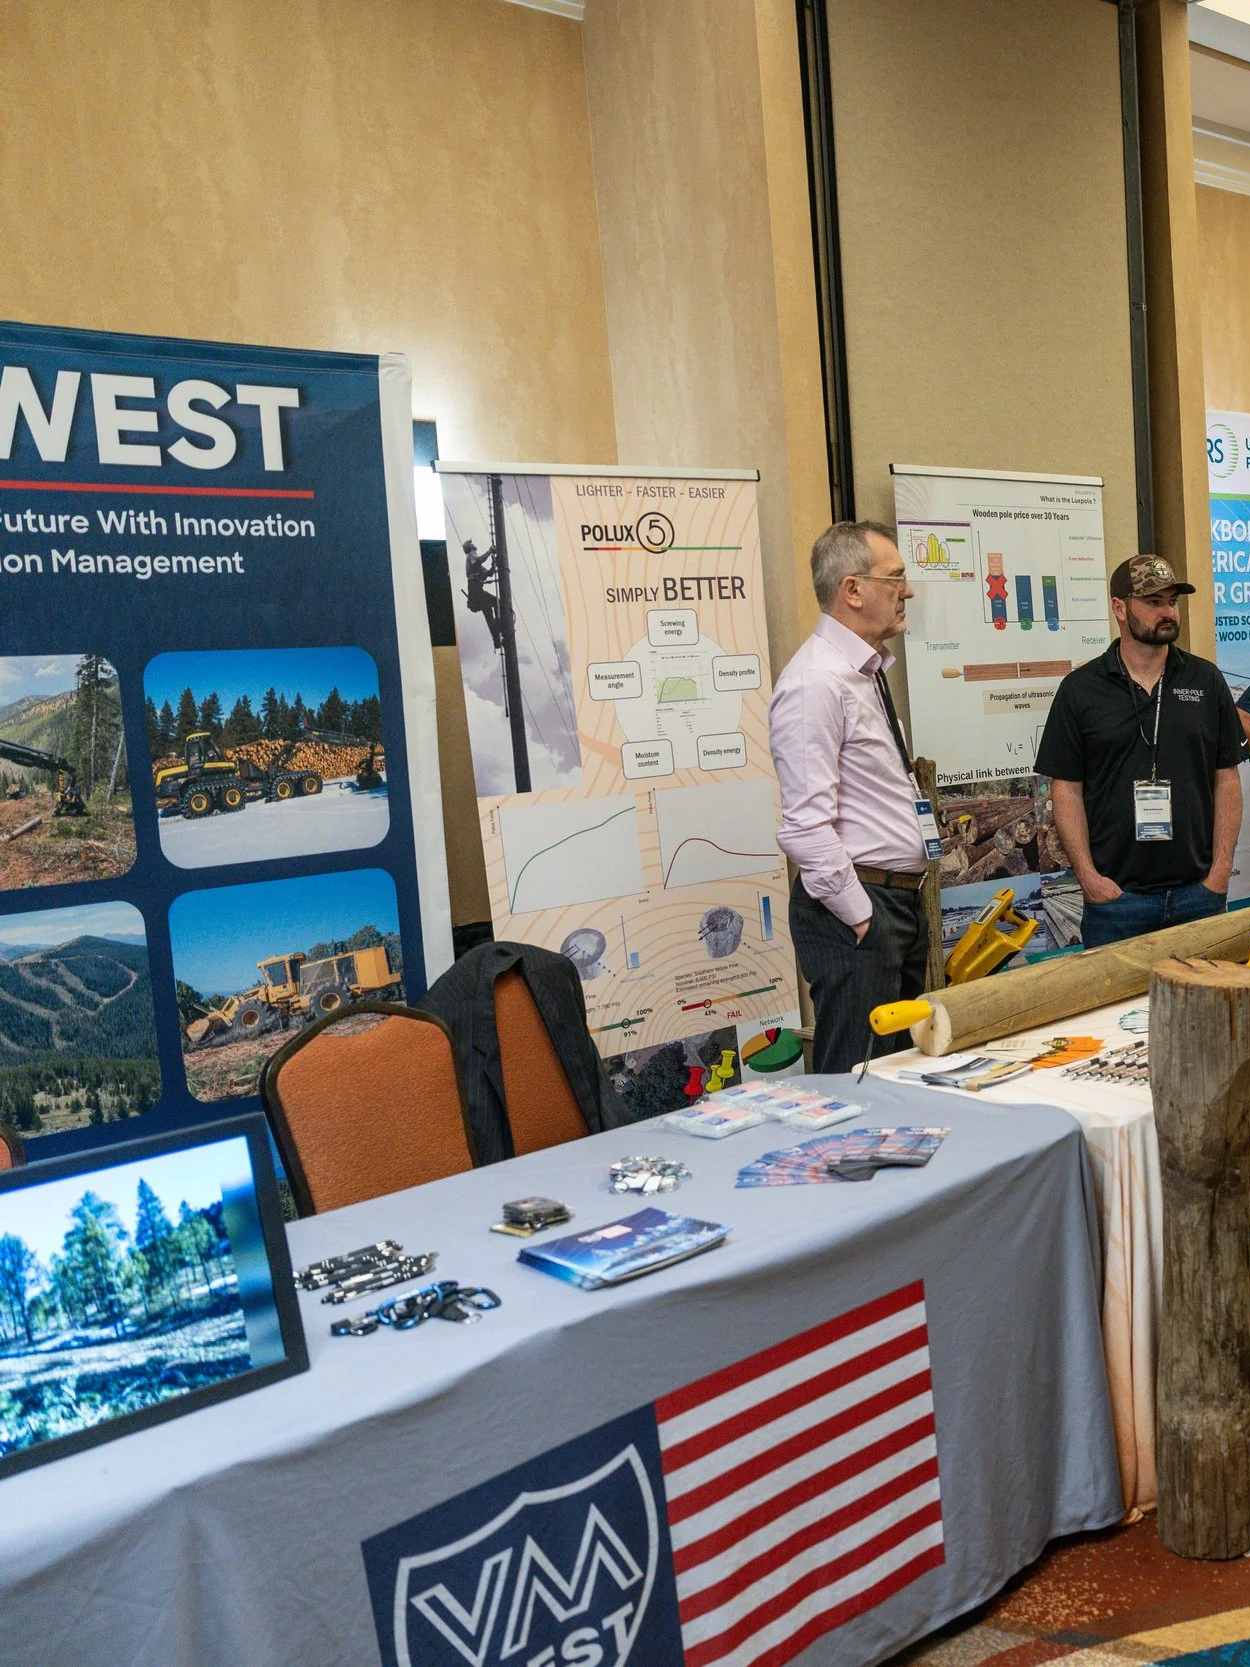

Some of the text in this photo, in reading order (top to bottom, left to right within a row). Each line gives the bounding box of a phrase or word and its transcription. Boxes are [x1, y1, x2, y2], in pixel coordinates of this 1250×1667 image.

[575, 484, 623, 498] LIGHTER
[636, 486, 677, 498] FASTER
[688, 487, 725, 499] EASIER
[1040, 495, 1055, 503] What
[1071, 497, 1092, 506] Luxpole
[972, 509, 1070, 521] Wooden pole price over 30 Years
[0, 509, 316, 537] uture With Innovation
[581, 524, 634, 543] POLUX
[51, 548, 245, 580] Management
[606, 575, 746, 604] SIMPLY BETTER
[660, 619, 685, 636] Screwing energy
[1081, 636, 1106, 645] Receiver
[1218, 630, 1248, 642] WOOD
[925, 641, 960, 651] Transmitter
[594, 671, 635, 680] Measurement
[718, 667, 756, 678] Density profile
[607, 680, 624, 689] angle
[989, 692, 1020, 702] Propagation
[1028, 690, 1054, 699] ultrasonic
[1172, 688, 1204, 697] INNER-POLE
[1178, 695, 1200, 703] TESTING
[1014, 702, 1030, 710] waves
[634, 750, 660, 759] Moisture
[702, 746, 742, 757] Density energy
[637, 758, 659, 768] content
[937, 765, 1030, 784] Physical link between
[768, 977, 783, 985] 100%
[636, 1008, 654, 1016] 100%
[726, 1010, 743, 1020] FAIL
[759, 1015, 785, 1027] Network
[623, 1030, 638, 1038] 91%
